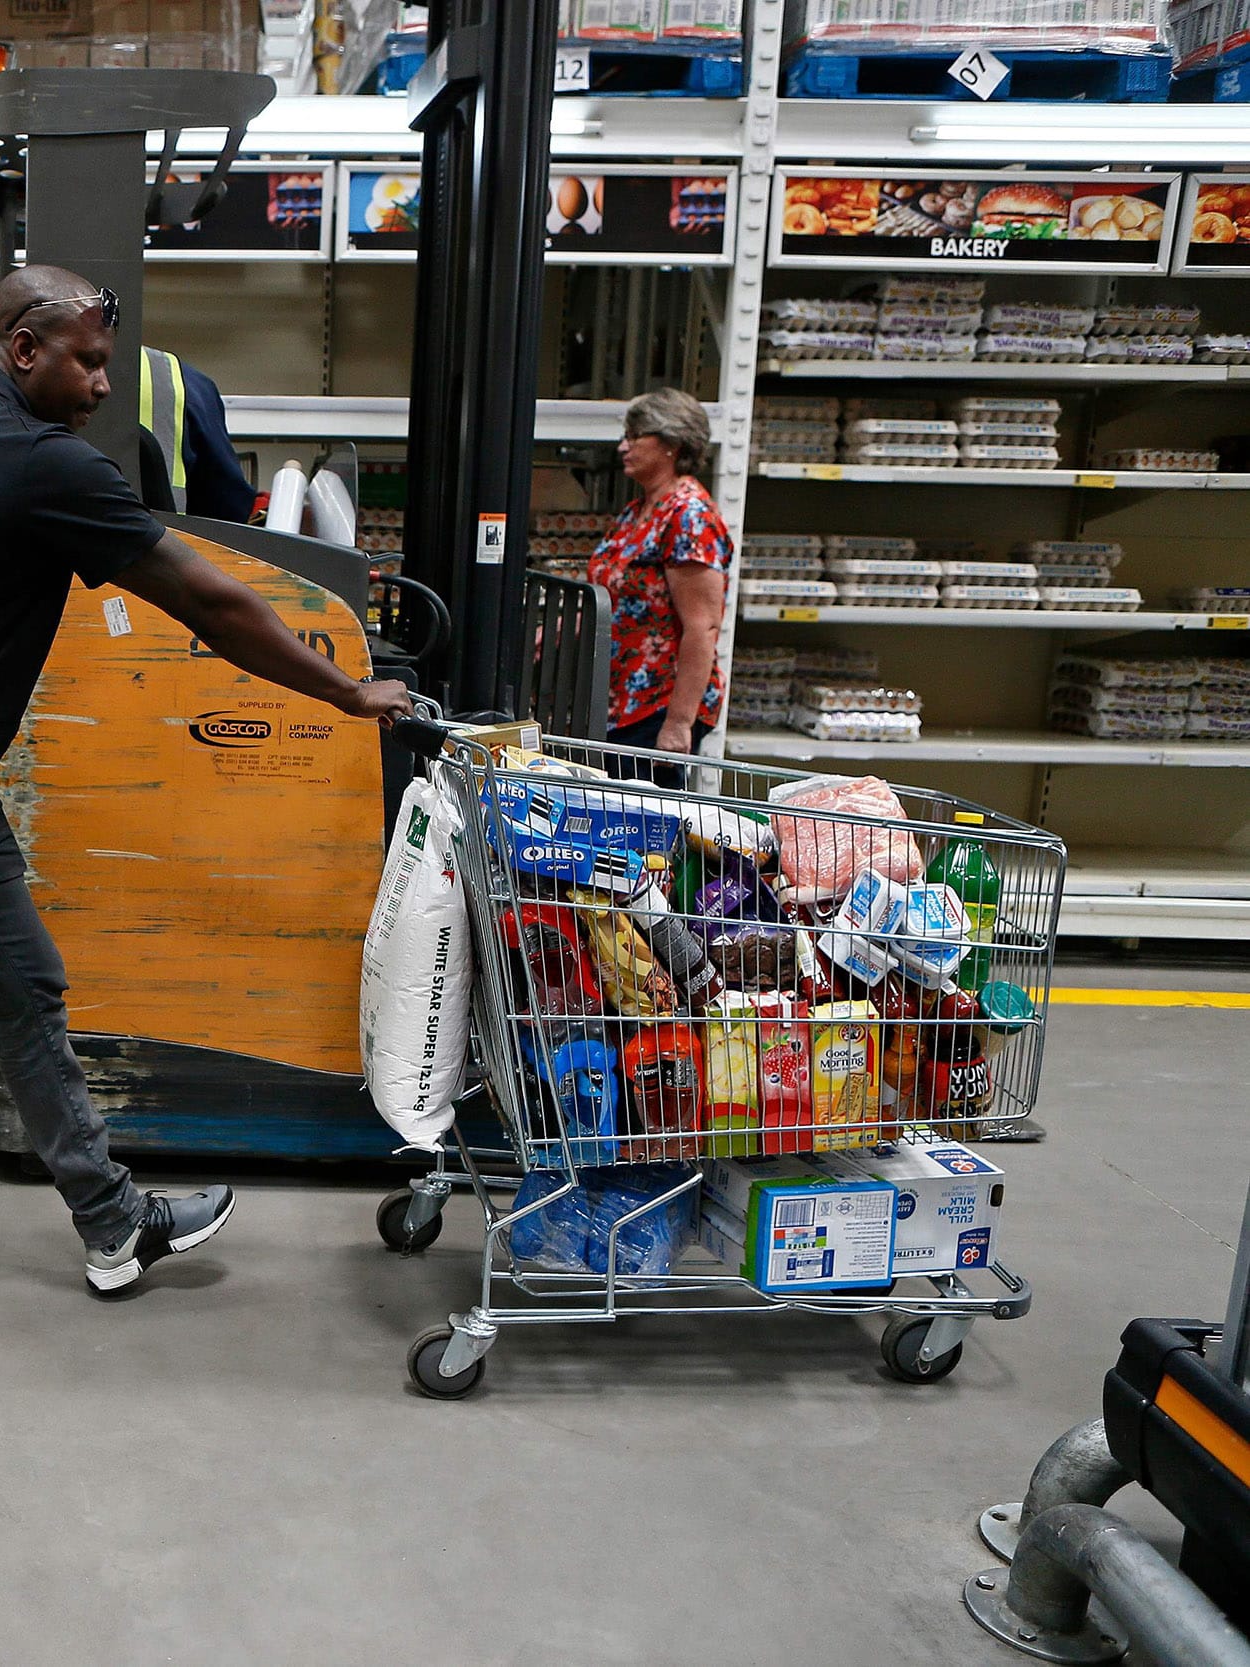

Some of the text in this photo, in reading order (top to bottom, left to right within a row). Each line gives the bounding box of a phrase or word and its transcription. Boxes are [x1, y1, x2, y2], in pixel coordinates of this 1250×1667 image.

[557, 59, 584, 80] 12
[959, 53, 987, 87] 07
[930, 237, 1009, 257] BAKERY
[238, 701, 275, 710] SUPPLIED
[207, 722, 269, 737] GOSCOR
[289, 724, 334, 733] LIFT TRUCK
[289, 732, 330, 740] COMPANY
[487, 782, 527, 800] OREO
[600, 825, 639, 839] OREO
[521, 846, 585, 862] OREO
[546, 863, 570, 871] Original
[436, 925, 452, 972] WHITE
[428, 973, 446, 1013] STAR
[423, 1013, 442, 1061] SUPER
[951, 1063, 987, 1084] YUM
[951, 1081, 989, 1099] YUM
[413, 1095, 426, 1114] kg
[950, 1196, 977, 1206] MILK
[938, 1205, 975, 1215] CREAM
[948, 1215, 974, 1224] FULL
